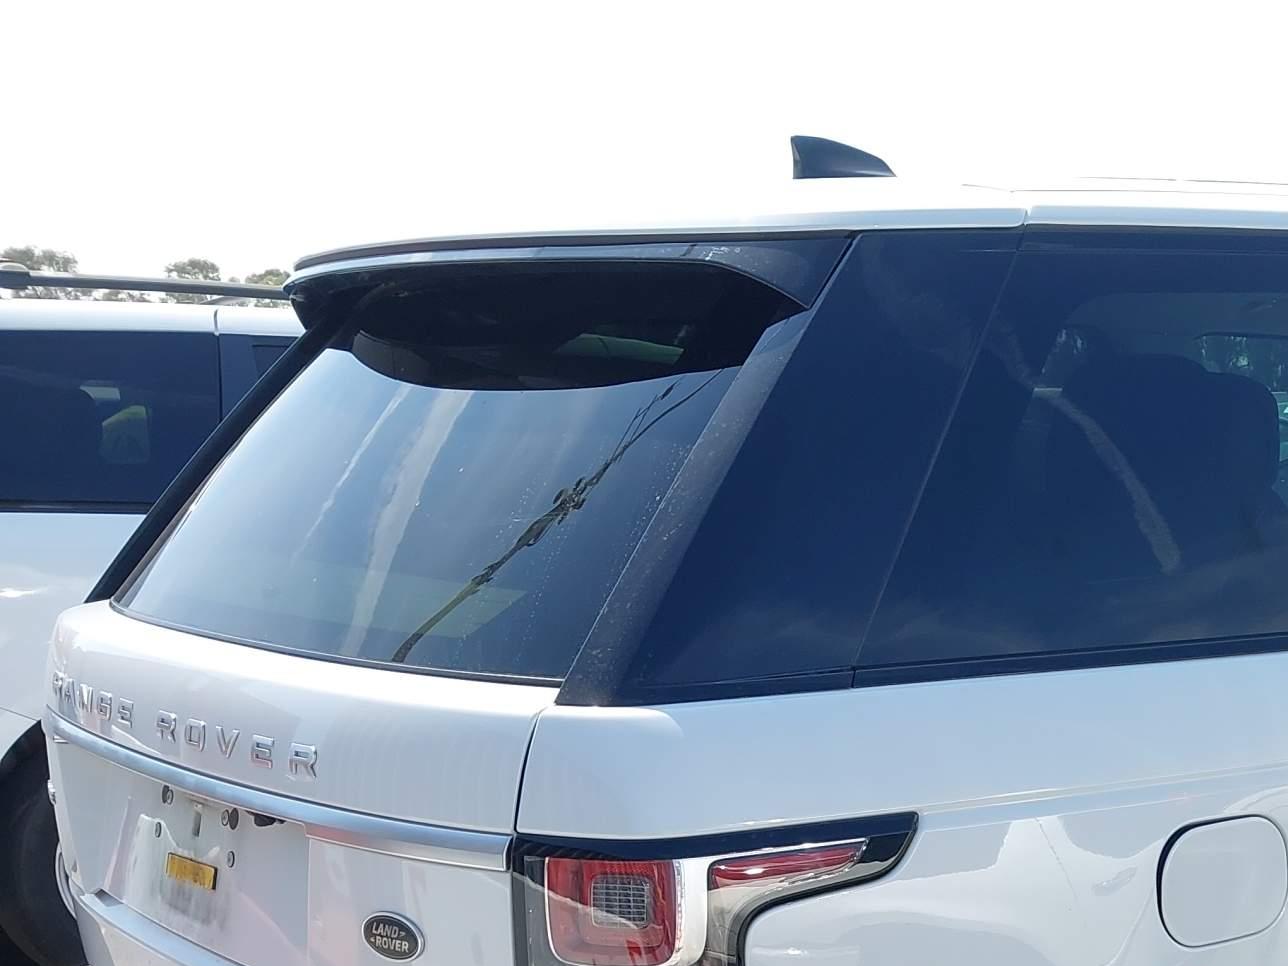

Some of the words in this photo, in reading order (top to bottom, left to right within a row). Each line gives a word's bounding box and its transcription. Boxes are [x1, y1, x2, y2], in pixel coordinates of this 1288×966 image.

[53, 671, 134, 729] RANGE
[156, 709, 319, 779] ROVER
[372, 922, 399, 939] LAND
[375, 935, 409, 953] ROVER
